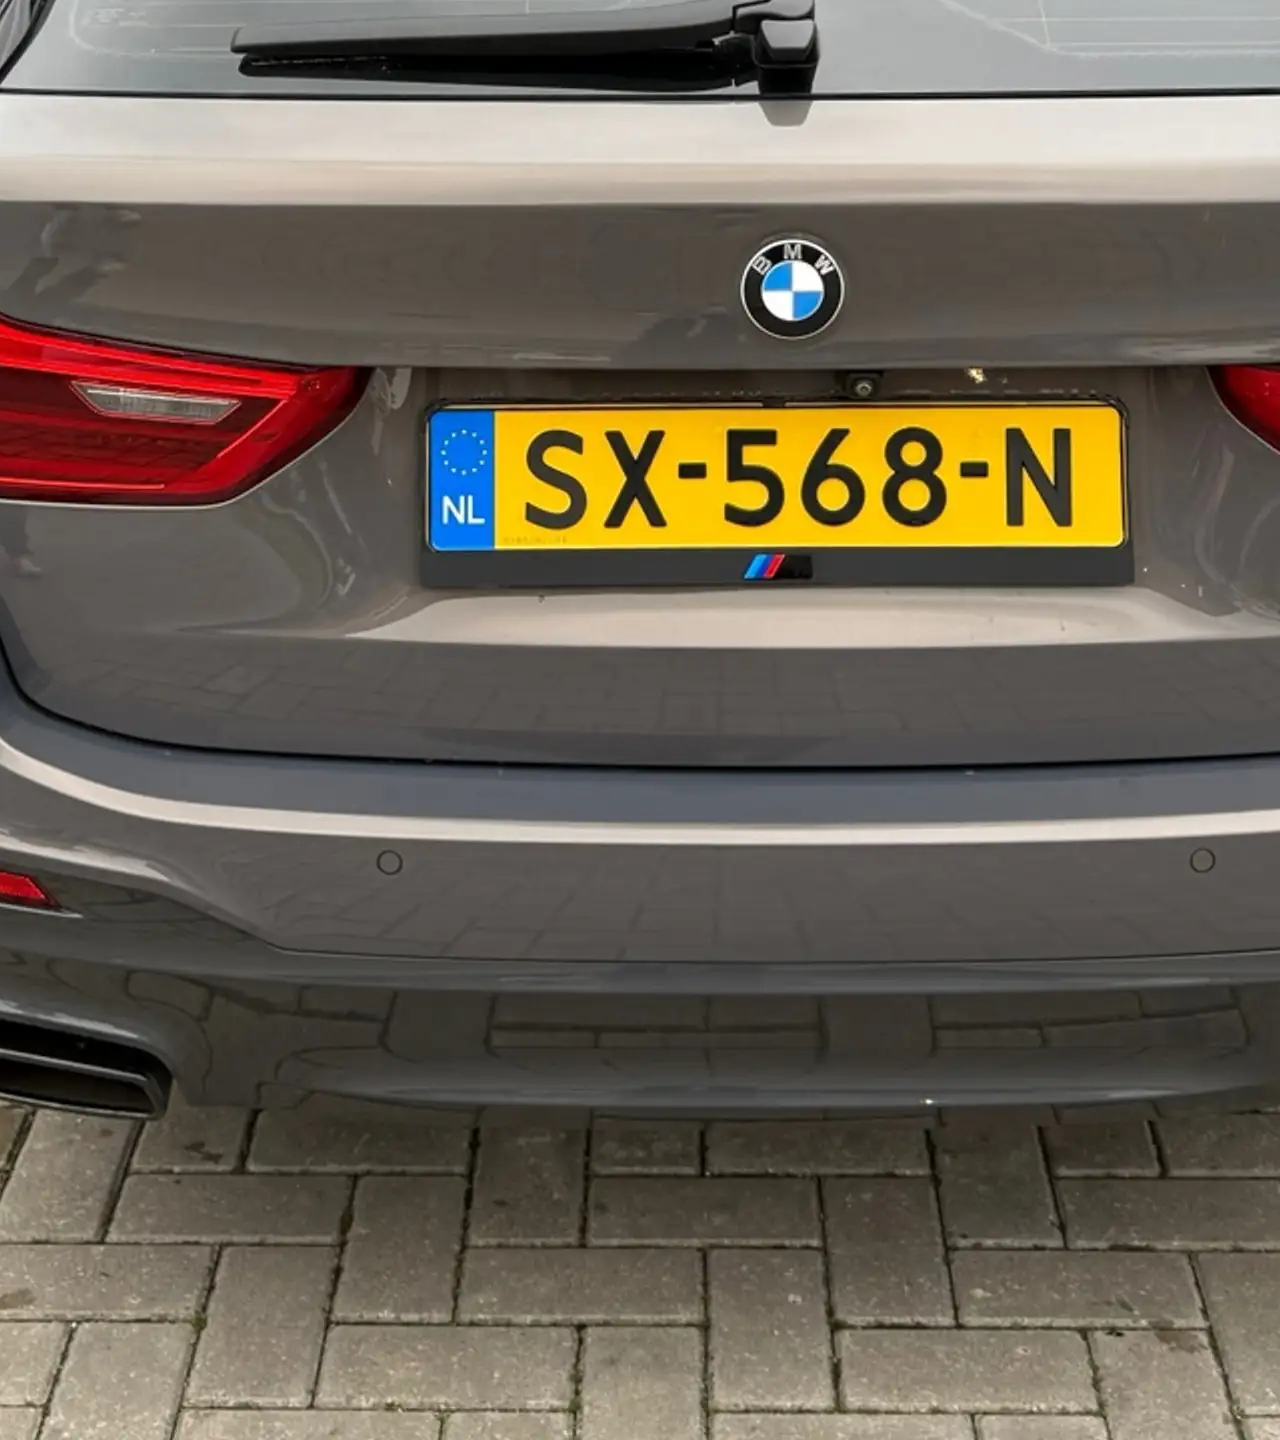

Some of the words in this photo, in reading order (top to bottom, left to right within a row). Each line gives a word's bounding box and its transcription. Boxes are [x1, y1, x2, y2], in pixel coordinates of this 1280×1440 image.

[752, 243, 835, 276] BMW
[526, 428, 1072, 529] SX-568-N
[443, 495, 485, 524] NL
